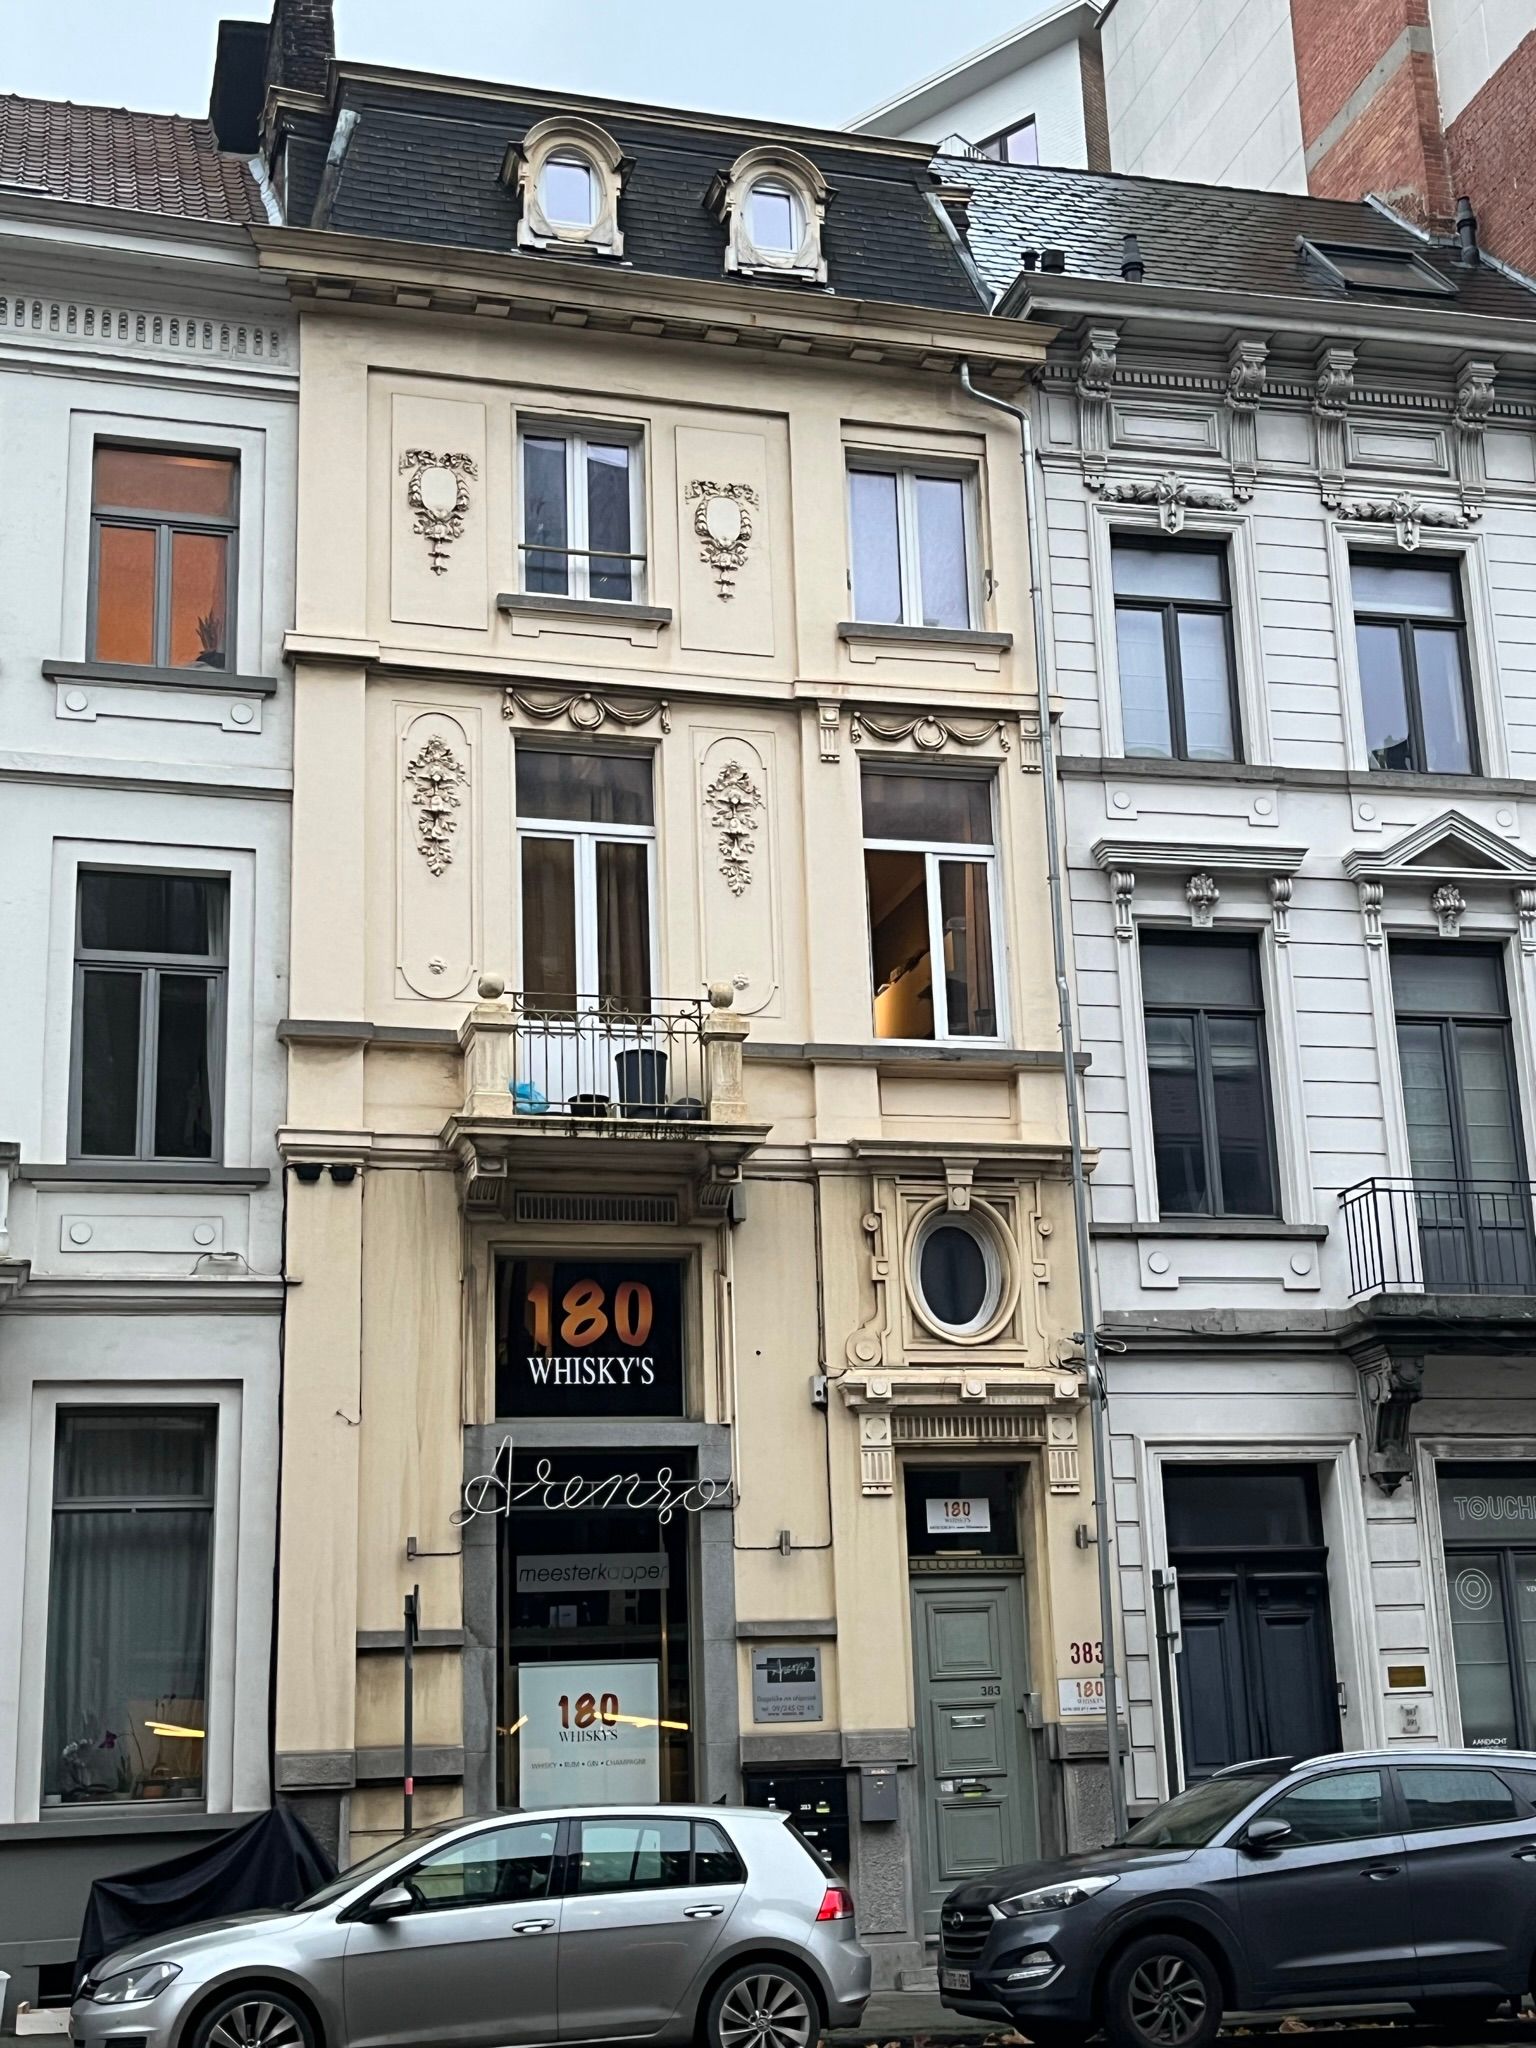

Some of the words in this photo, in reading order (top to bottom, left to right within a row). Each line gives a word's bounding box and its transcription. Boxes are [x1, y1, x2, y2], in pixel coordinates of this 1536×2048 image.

[527, 1278, 653, 1348] 180
[527, 1356, 655, 1386] WHISKY'S
[943, 1501, 971, 1517] 180
[1453, 1496, 1536, 1520] TOUCH
[519, 1563, 668, 1584] meesterkapper
[1070, 1641, 1104, 1665] 383
[980, 1685, 1001, 1697] 383
[1076, 1680, 1104, 1698] 180
[558, 1692, 619, 1730] 180
